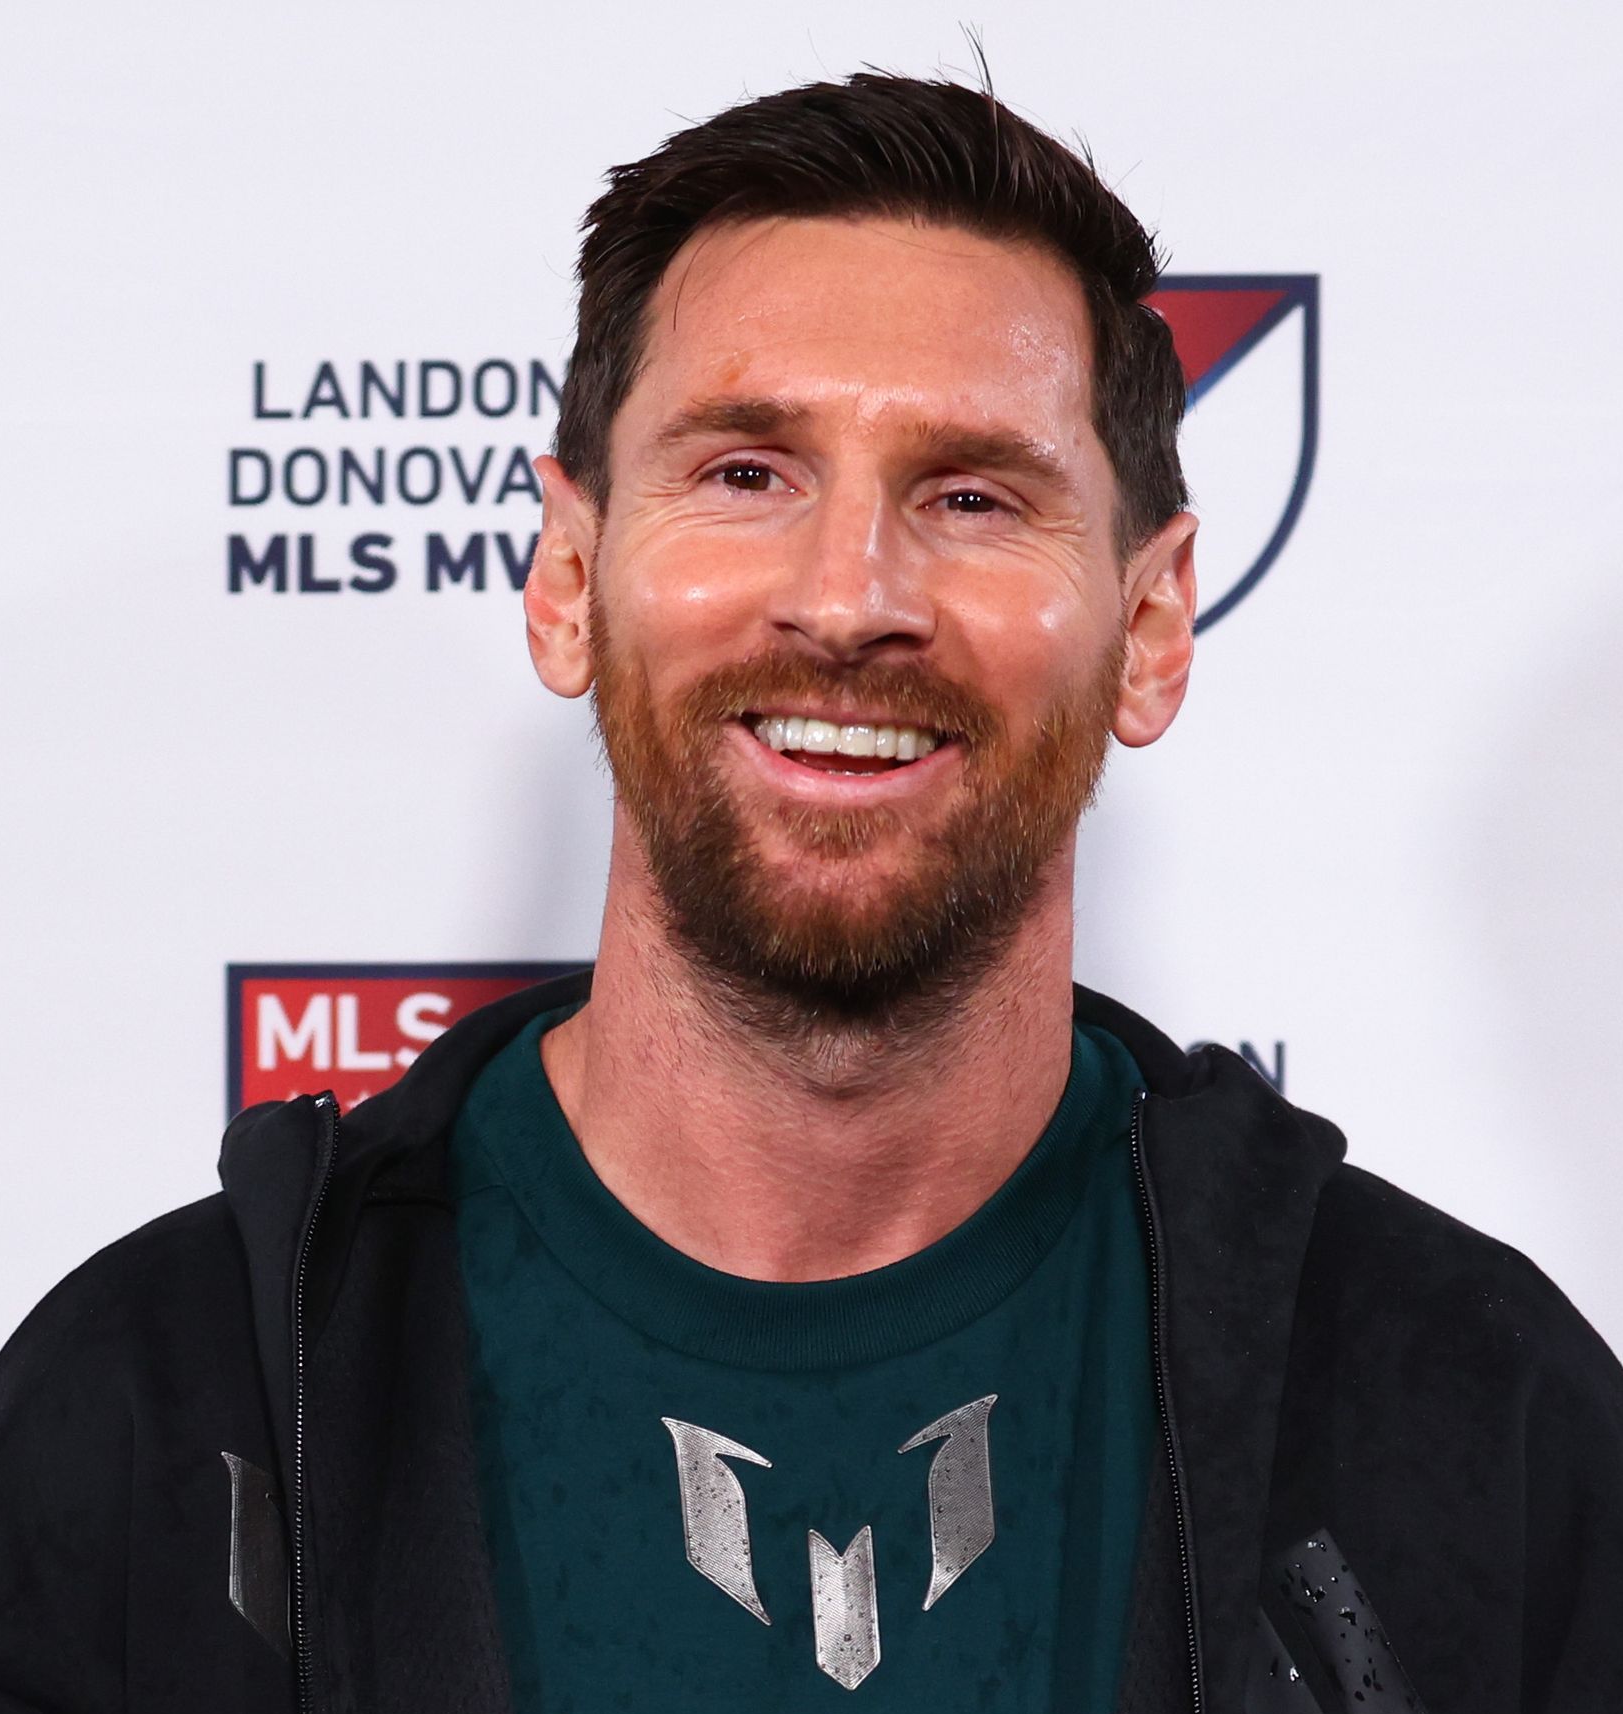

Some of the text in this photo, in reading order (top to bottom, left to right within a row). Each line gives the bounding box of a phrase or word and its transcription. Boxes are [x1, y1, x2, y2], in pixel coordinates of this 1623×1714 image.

[253, 360, 563, 419] LANDON
[229, 446, 543, 506] DONOVA
[227, 532, 541, 593] MLS MV
[256, 991, 453, 1071] MLS
